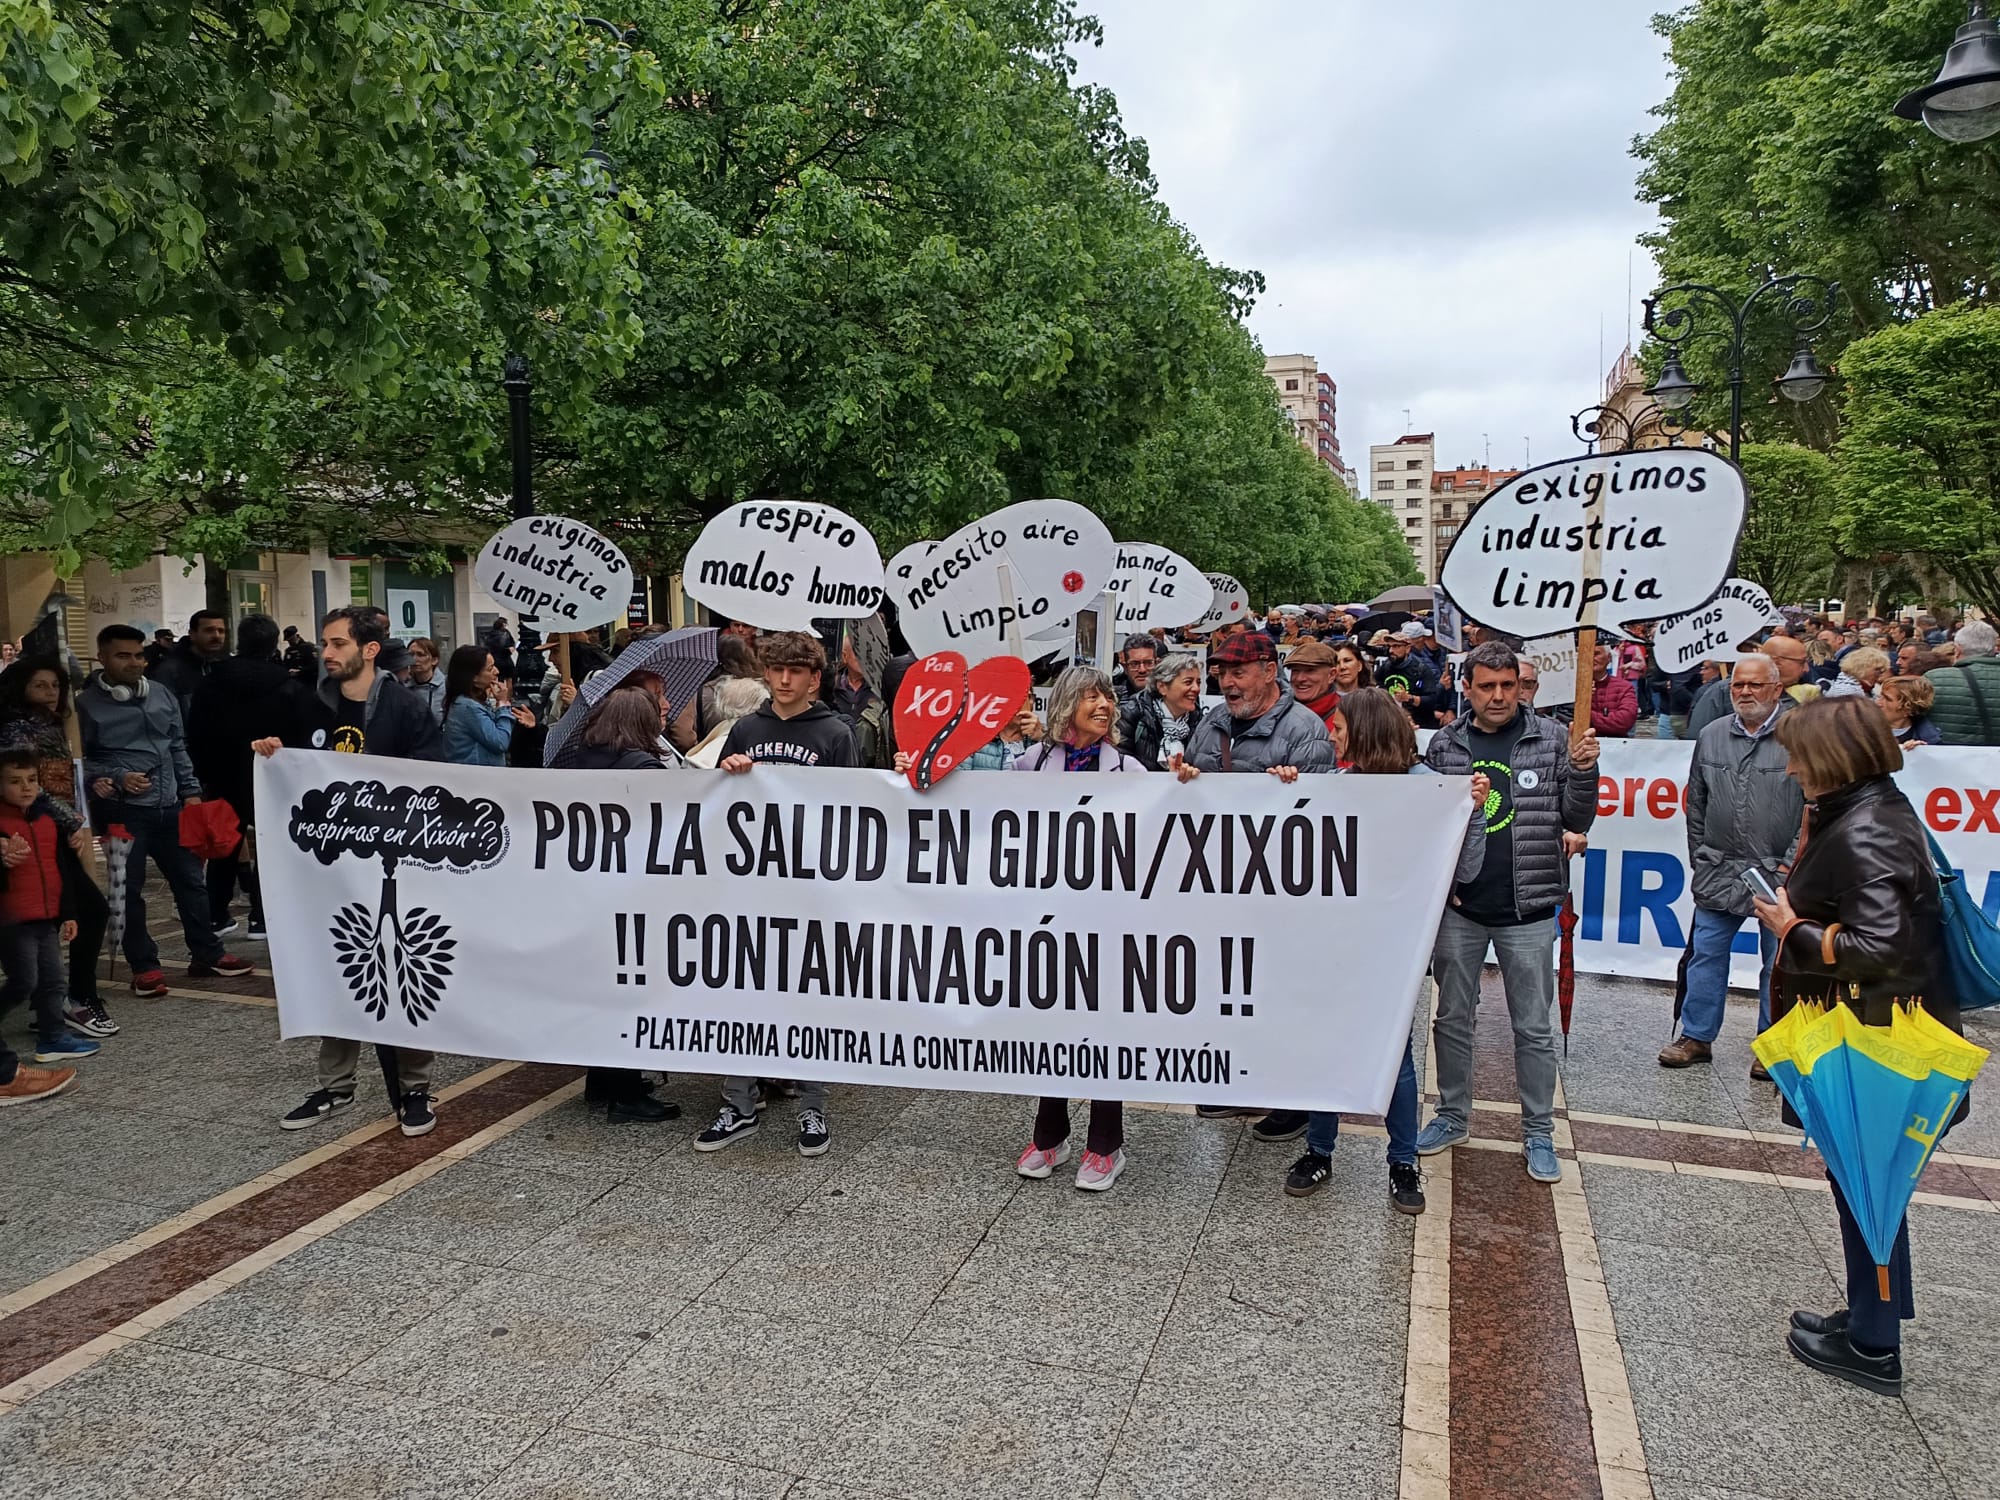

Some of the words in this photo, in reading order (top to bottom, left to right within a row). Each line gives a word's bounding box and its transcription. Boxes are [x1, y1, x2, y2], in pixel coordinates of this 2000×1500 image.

[1515, 461, 1706, 508] exigimos
[529, 519, 626, 574] exigimos
[739, 507, 856, 548] respiro
[1482, 514, 1667, 553] industria
[492, 536, 608, 601] industria
[699, 550, 795, 596] malos
[807, 565, 883, 609] humos
[907, 526, 1007, 610] necesito
[1022, 519, 1079, 546] aire
[1107, 578, 1133, 593] or
[1115, 549, 1177, 577] hando
[492, 571, 579, 620] limpia
[1115, 601, 1151, 621] lud
[1492, 567, 1662, 622] limpia
[942, 597, 1049, 642] limpio
[1692, 608, 1723, 631] nos
[1678, 629, 1729, 664] mata
[325, 791, 347, 819] y
[405, 789, 440, 823] qué
[1596, 776, 1689, 820] ere
[1925, 786, 2000, 833] ex
[296, 818, 380, 851] respiras
[383, 826, 407, 846] en
[532, 800, 632, 874] POR
[645, 802, 707, 876] LA
[725, 801, 888, 882] SALUD
[907, 808, 970, 885] EN
[401, 858, 444, 873] Plataforma
[615, 913, 647, 986] !!
[667, 913, 1099, 1012] CONTAMINACIÓN
[1122, 933, 1197, 1015] NO
[1220, 936, 1255, 1017] !!
[635, 1016, 779, 1057] PLATAFORMA
[787, 1025, 873, 1065] CONTRA
[880, 1032, 906, 1067] LA
[913, 1035, 1109, 1080] CONTAMINACIÓN
[1118, 1046, 1148, 1081] DE
[1155, 1042, 1231, 1085] XIXÓN
